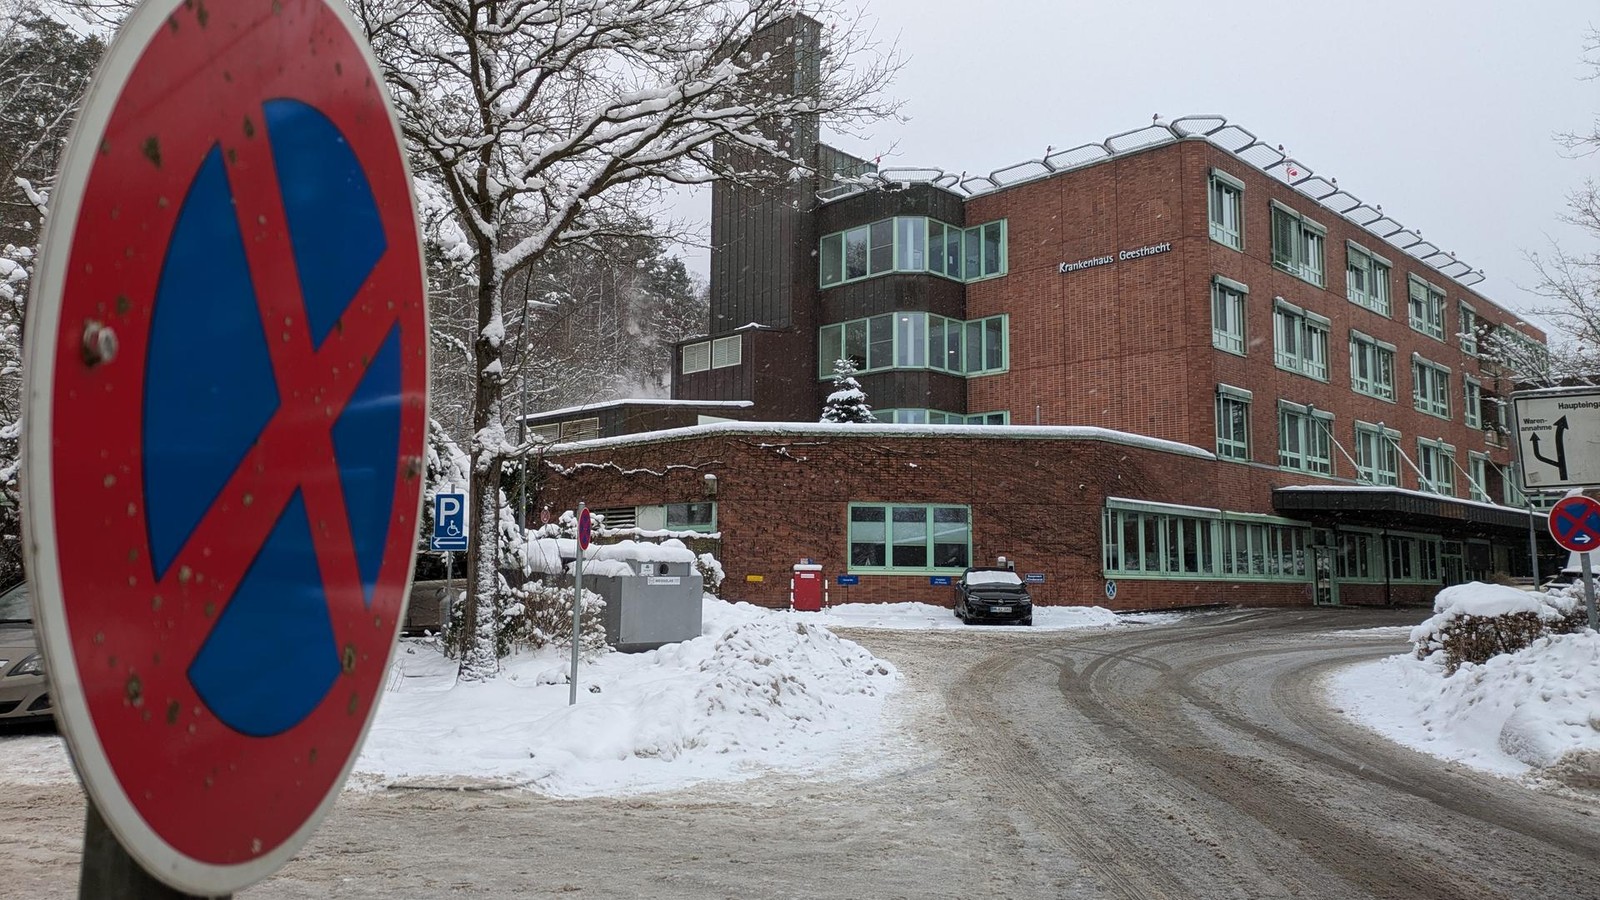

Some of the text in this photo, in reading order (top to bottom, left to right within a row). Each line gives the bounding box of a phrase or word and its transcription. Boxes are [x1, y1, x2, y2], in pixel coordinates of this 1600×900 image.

[1059, 242, 1171, 273] Krankenhaus Geesthacht
[1558, 400, 1600, 410] Haupteing
[439, 497, 460, 526] P
